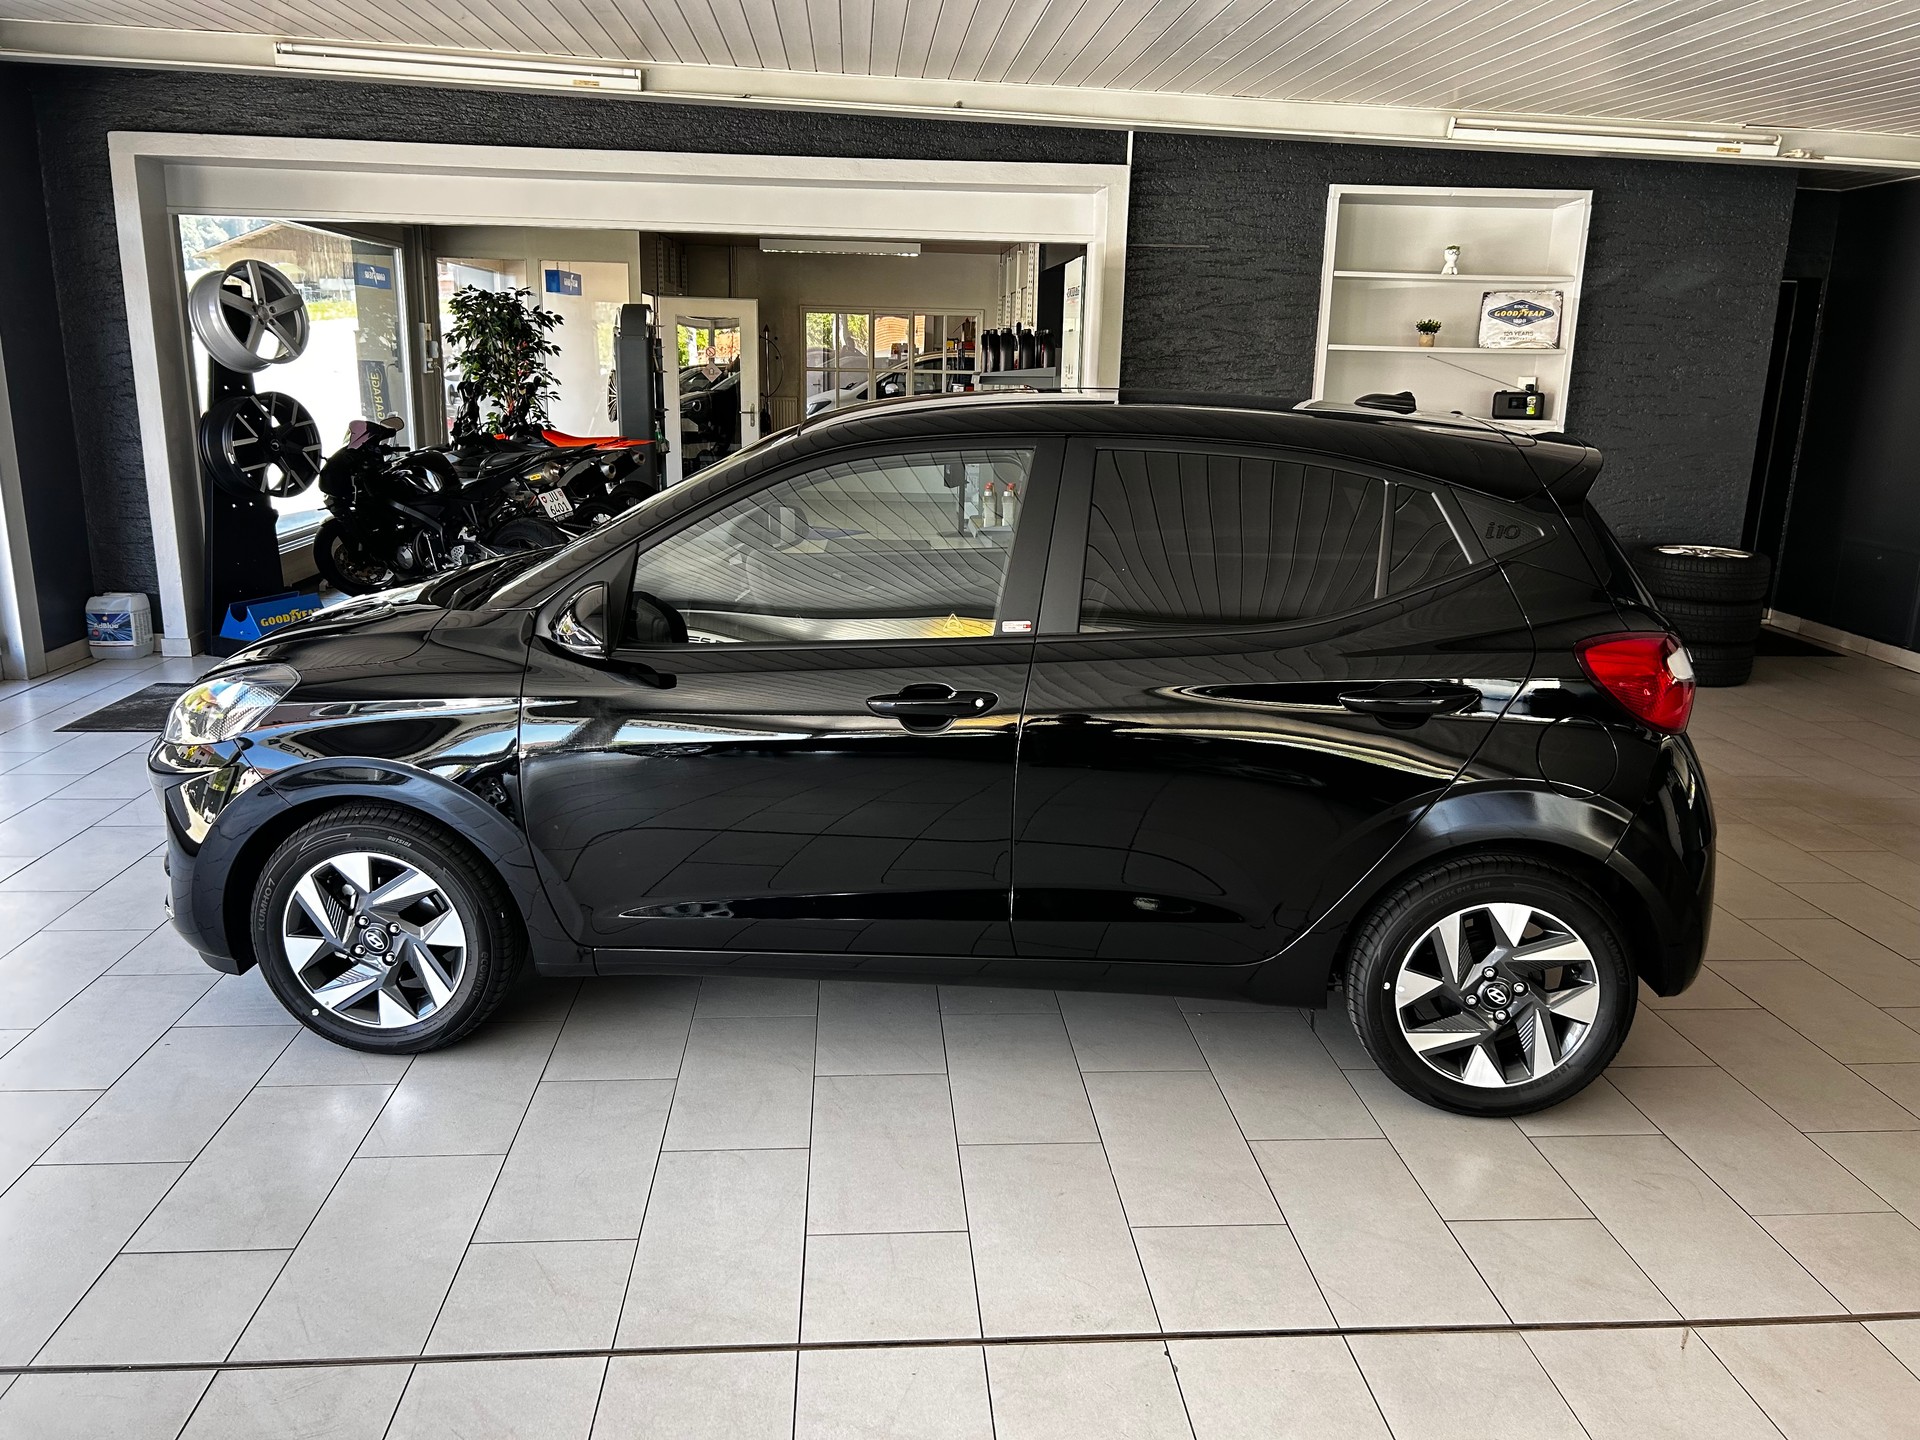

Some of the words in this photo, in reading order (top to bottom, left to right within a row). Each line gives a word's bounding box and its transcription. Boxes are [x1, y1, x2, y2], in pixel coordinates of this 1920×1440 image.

[1494, 308, 1546, 319] GOODYEAR
[550, 501, 570, 515] 6401
[1485, 521, 1521, 540] i10
[94, 621, 119, 629] AdBlue
[387, 835, 412, 847] OUTSIDE
